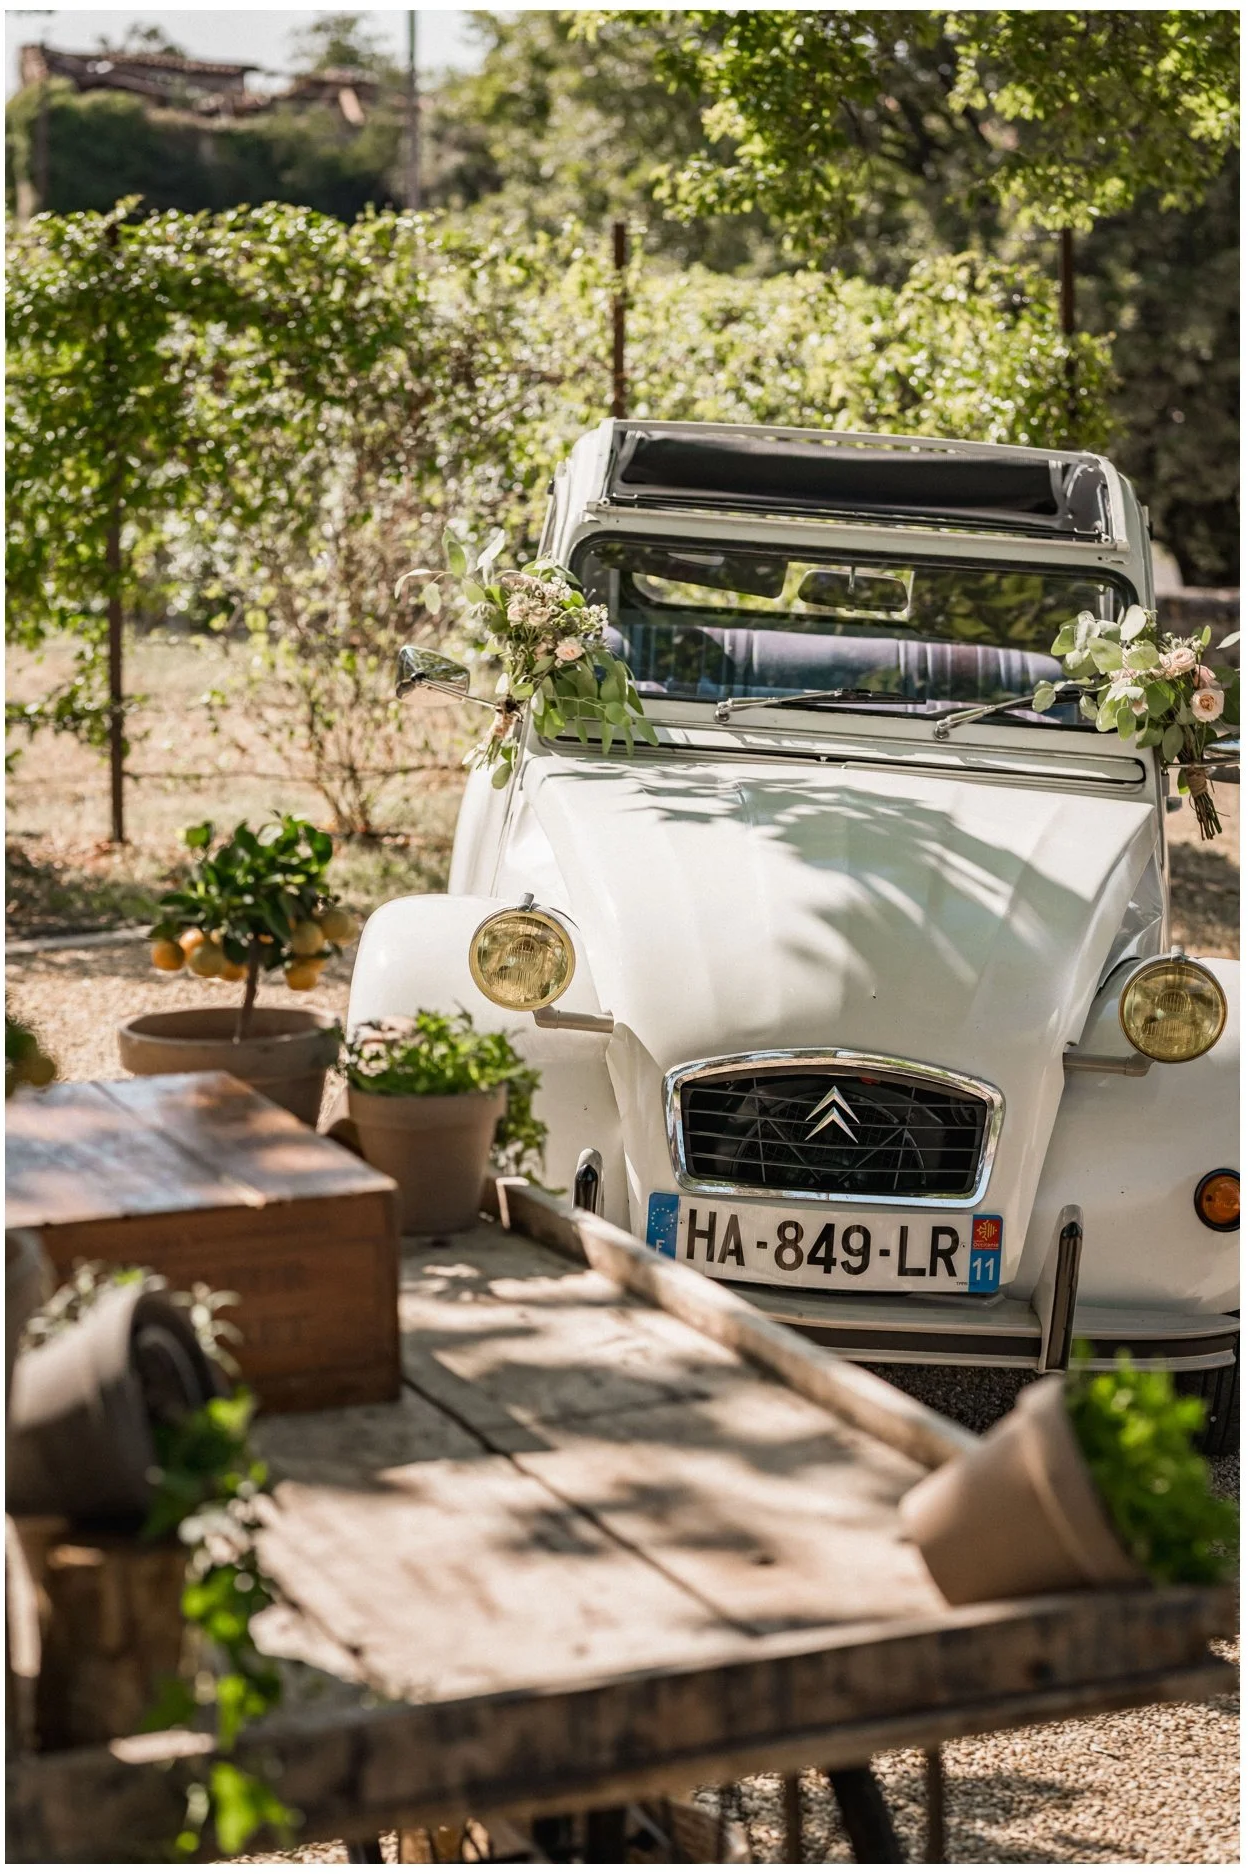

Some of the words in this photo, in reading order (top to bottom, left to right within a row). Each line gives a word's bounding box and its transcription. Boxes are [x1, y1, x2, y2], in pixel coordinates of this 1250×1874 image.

[656, 1239, 665, 1254] F
[686, 1208, 960, 1278] HA-849-LR
[972, 1257, 995, 1281] 11
